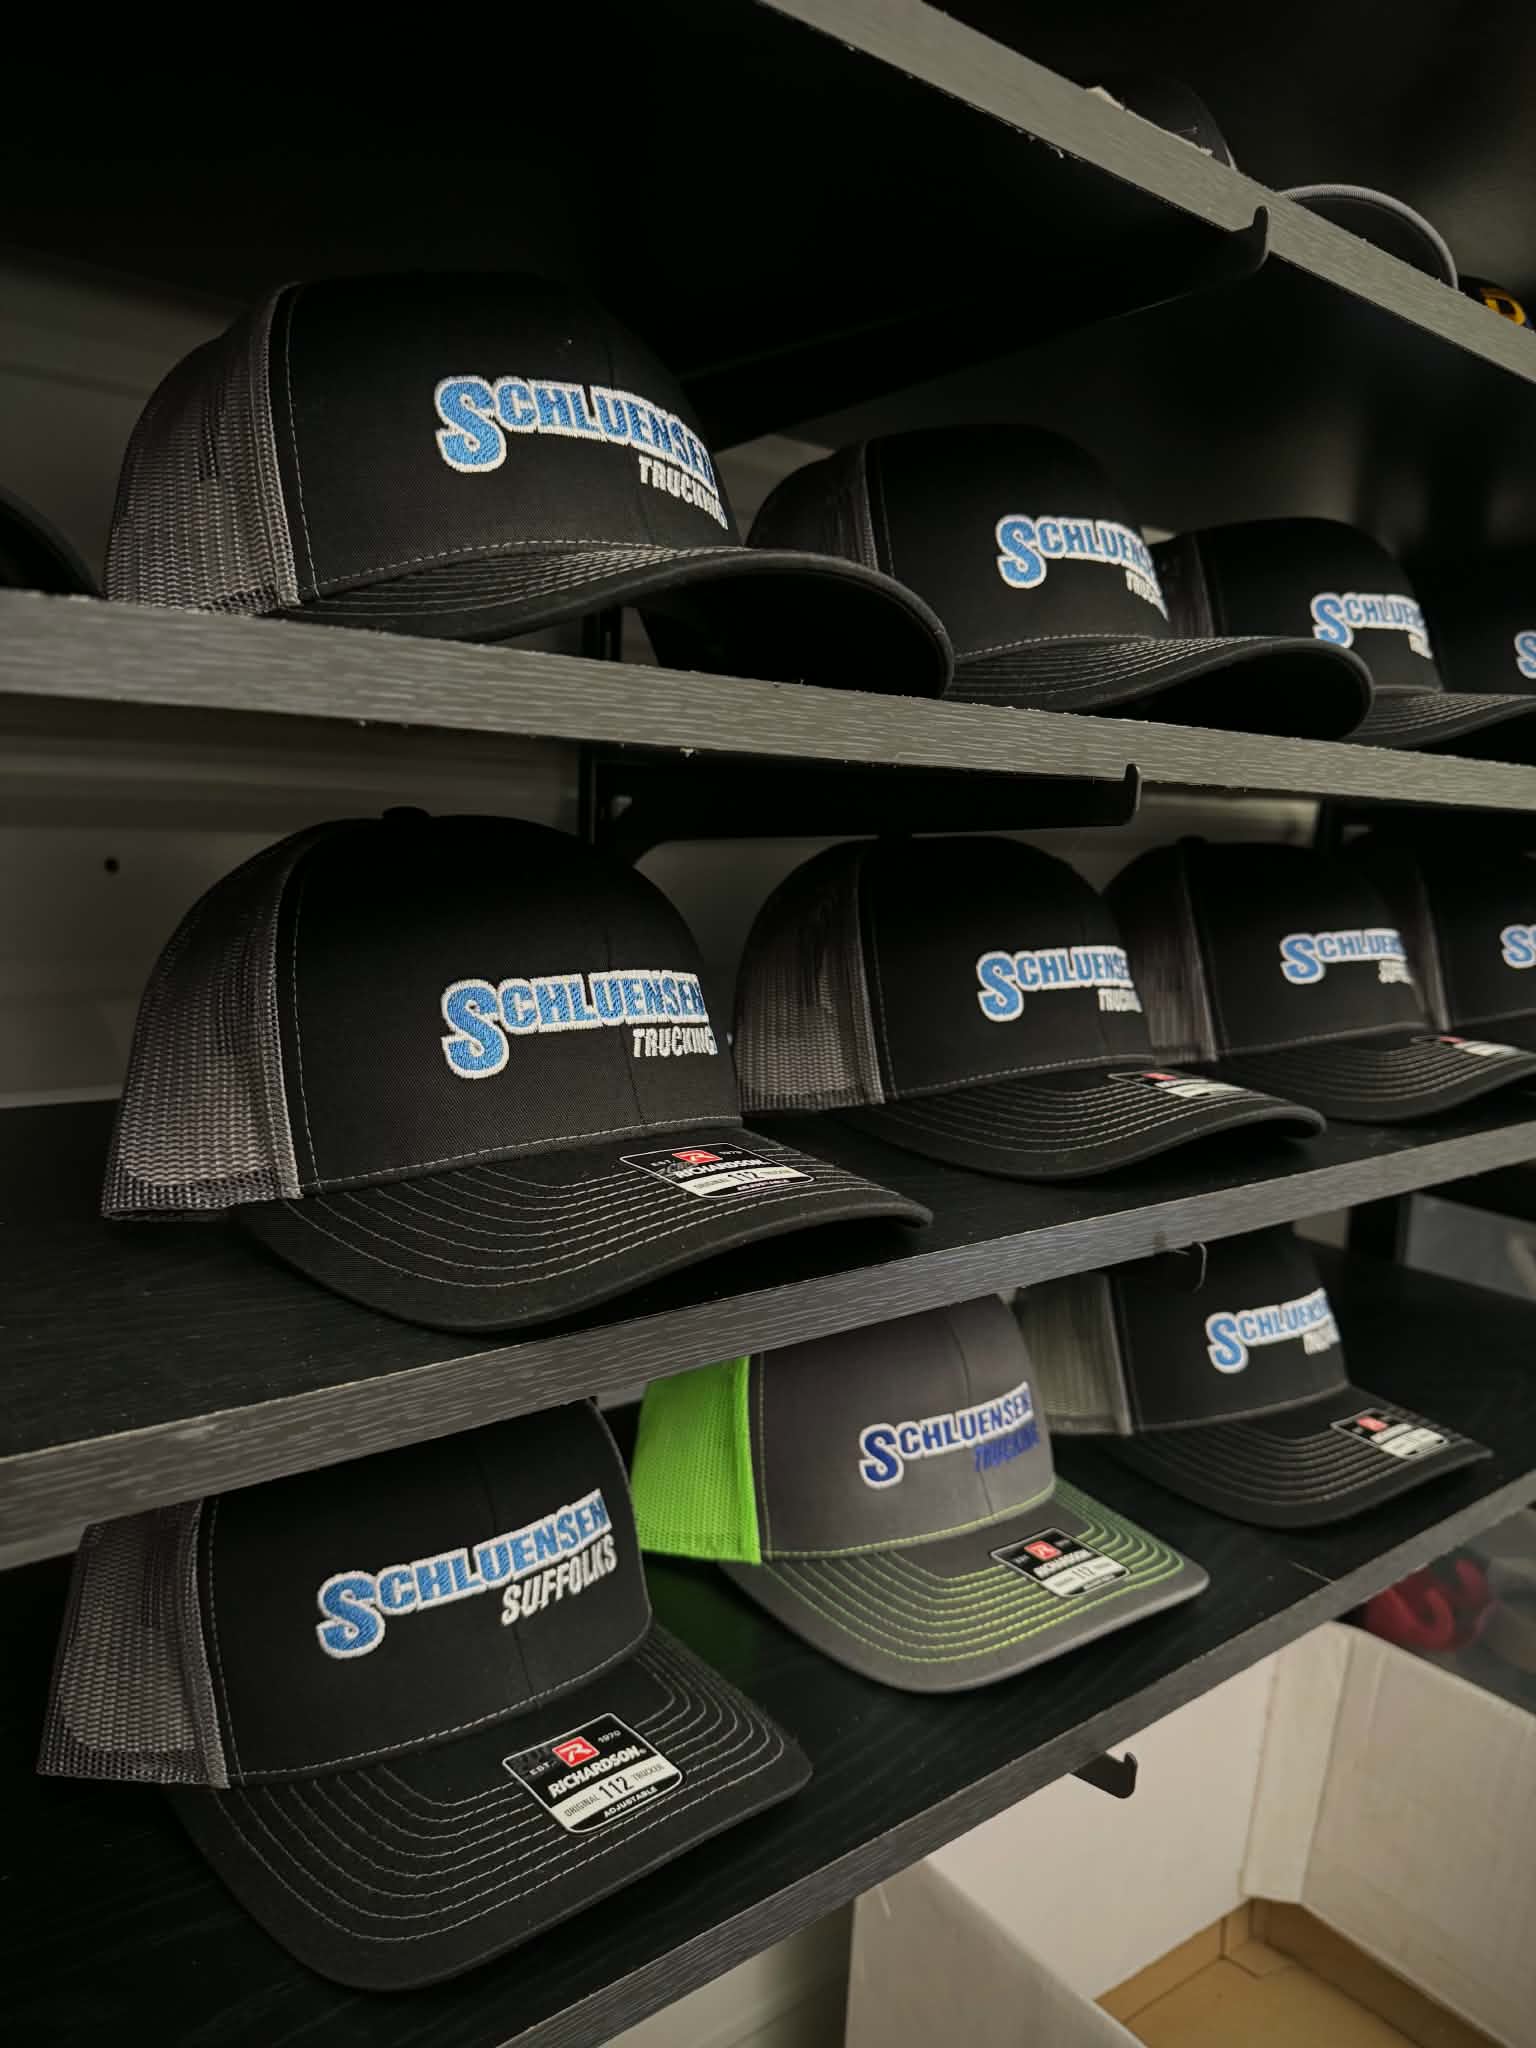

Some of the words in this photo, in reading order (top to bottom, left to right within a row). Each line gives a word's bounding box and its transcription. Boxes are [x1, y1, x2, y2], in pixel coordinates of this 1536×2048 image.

[434, 376, 720, 499] SCHLUENSEN
[440, 969, 710, 1080] SCHLUENSEN
[632, 1025, 719, 1058] TRUCKING
[859, 1381, 1034, 1489] SCHLUENSEN
[316, 1488, 613, 1659] SCHLUENSEN
[501, 1534, 618, 1627] SUFFOLKS
[548, 1745, 642, 1799] RICHARDSON
[600, 1776, 635, 1799] 112
